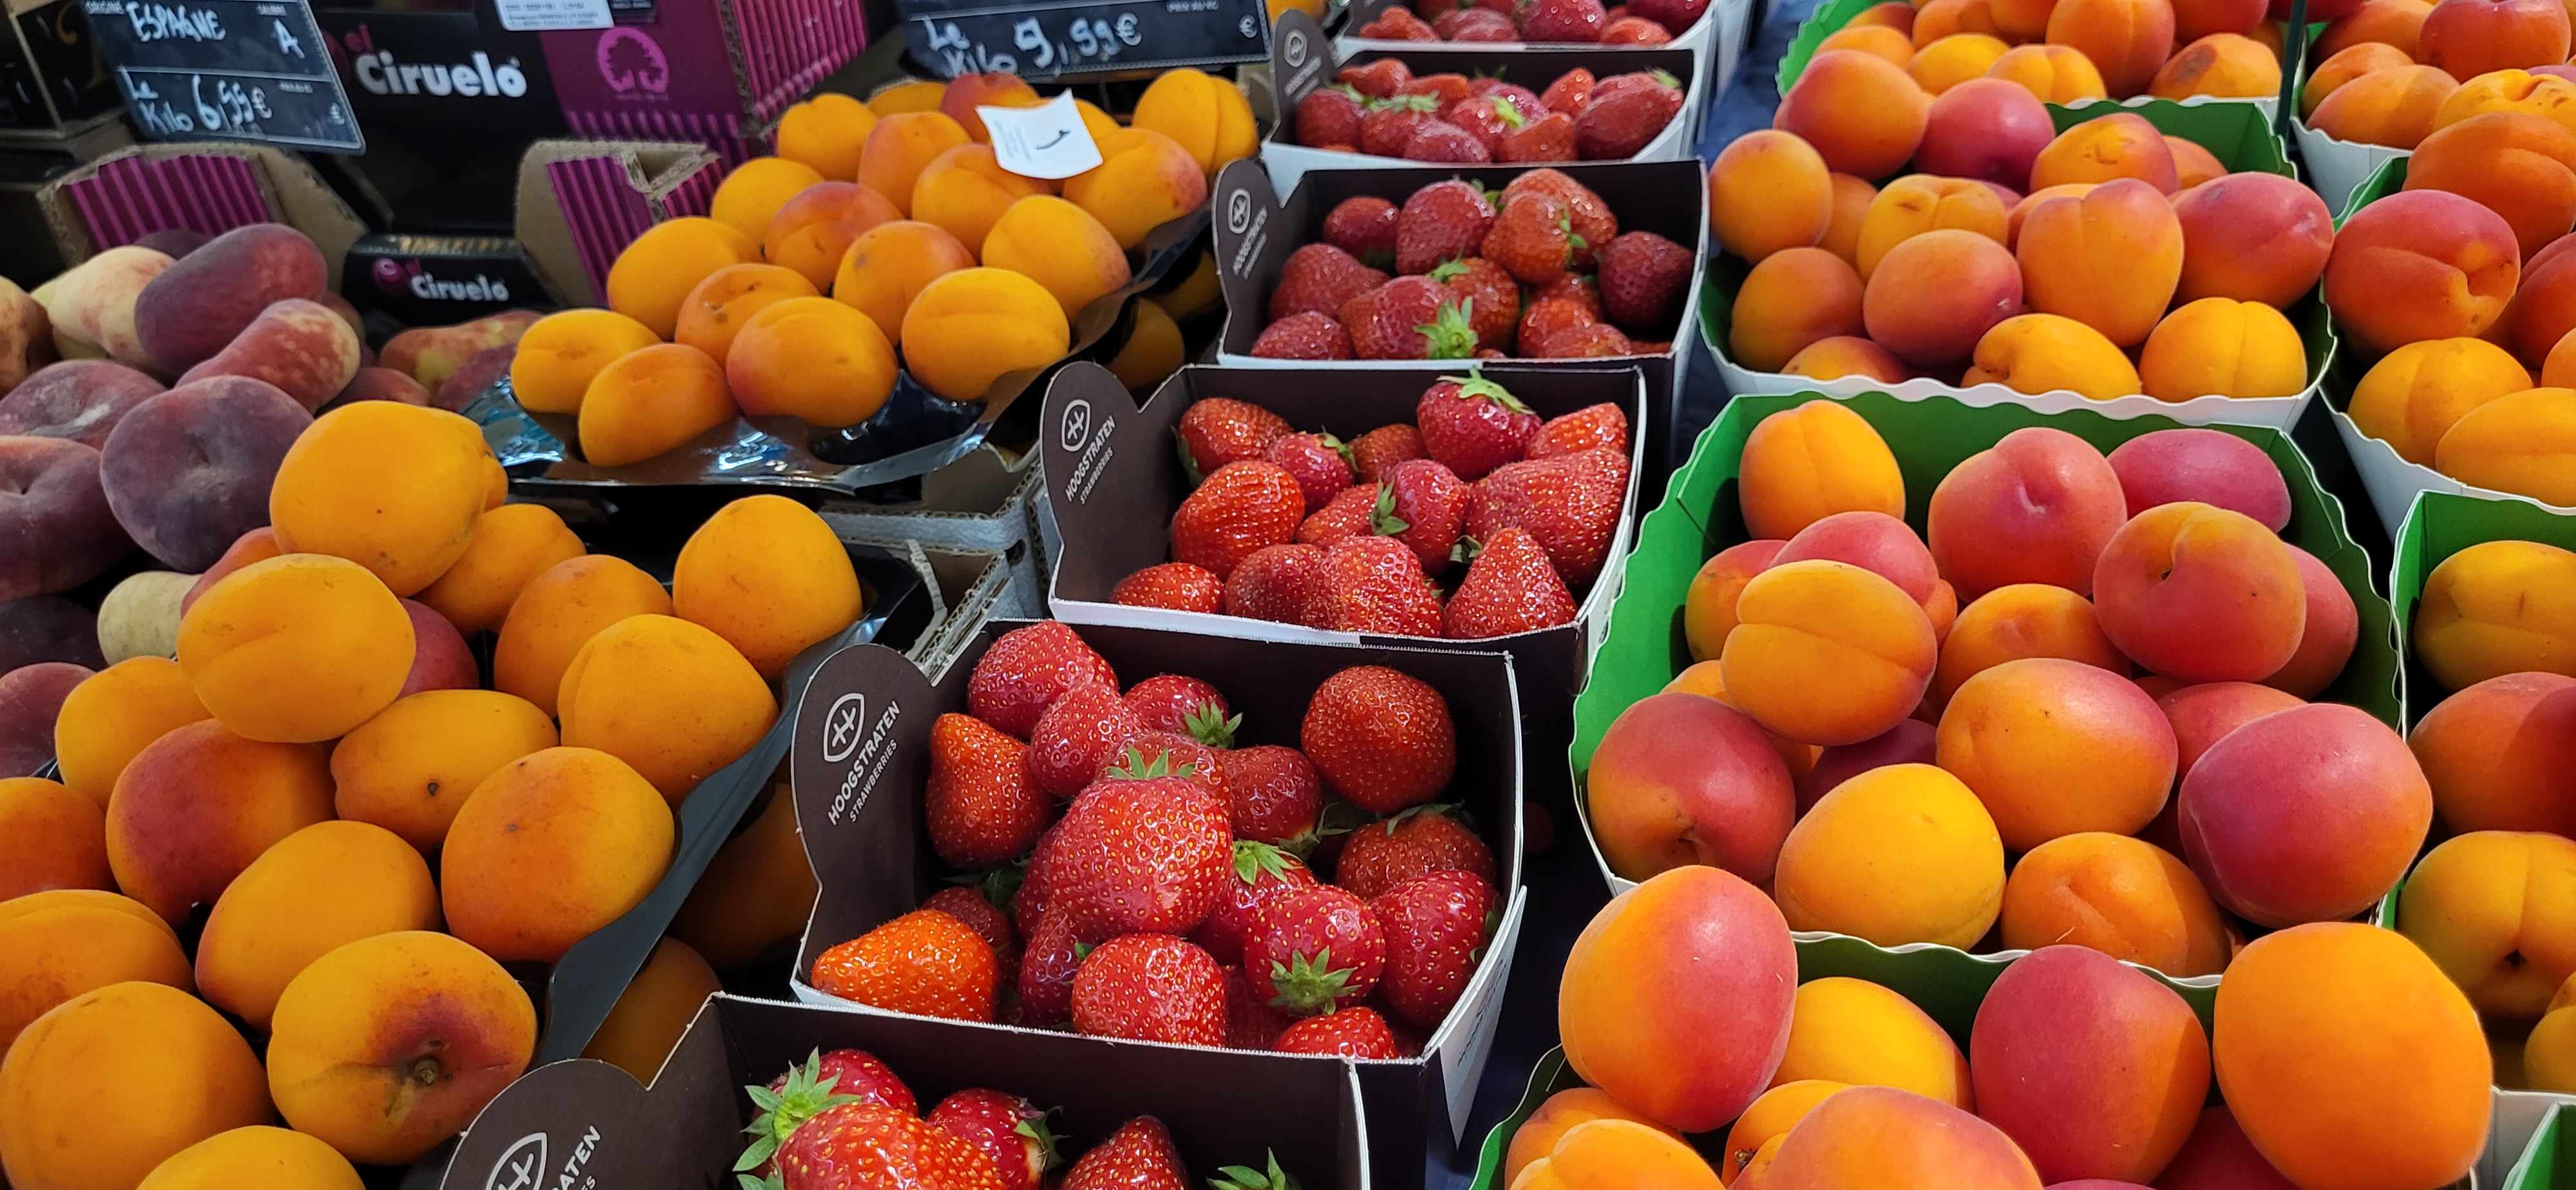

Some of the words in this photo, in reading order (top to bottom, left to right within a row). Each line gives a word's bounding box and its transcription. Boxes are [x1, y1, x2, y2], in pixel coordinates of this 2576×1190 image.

[126, 2, 226, 42] ESPAGNE
[272, 18, 305, 59] A
[923, 15, 971, 52] Le
[355, 48, 527, 98] Ciruelo
[411, 271, 510, 302] Ciruelo
[1065, 415, 1117, 502] HOOGSTRATEN
[1079, 447, 1114, 505] STRAWBERRIES
[827, 699, 902, 826] HOOGSTRATEN
[849, 738, 898, 823] STRAWBERRIES
